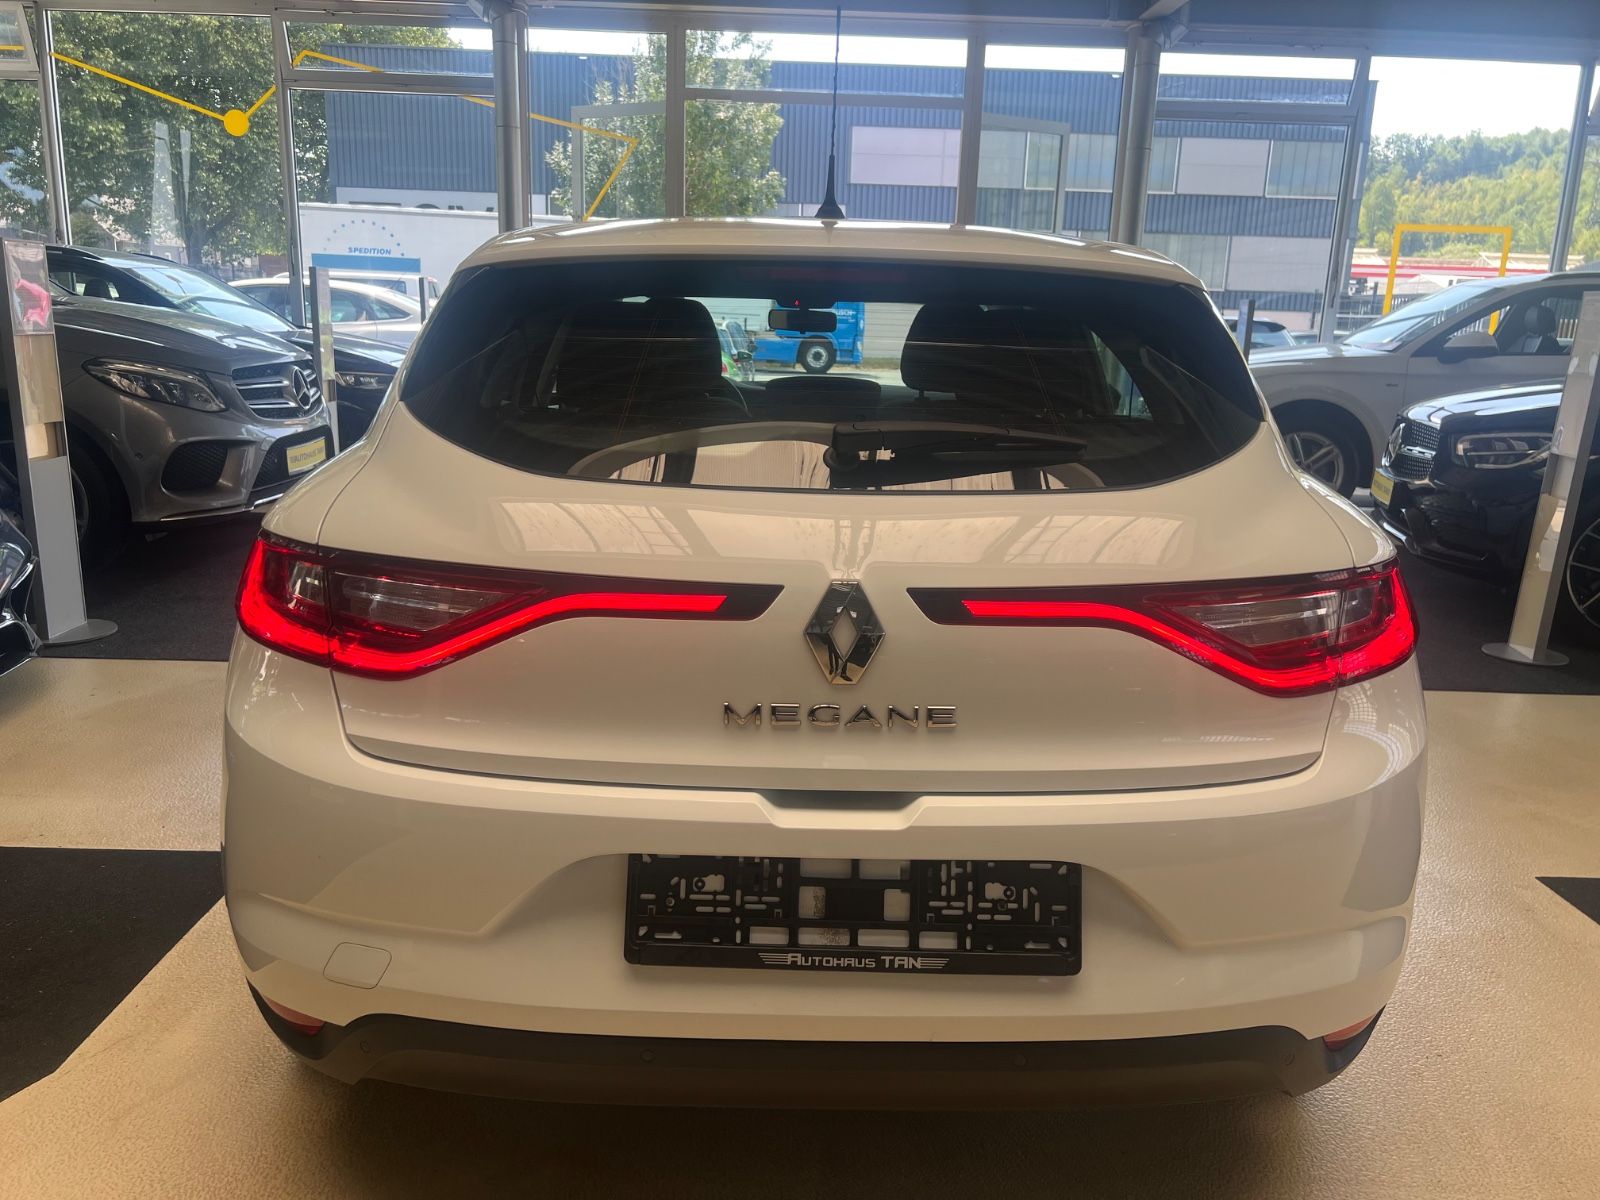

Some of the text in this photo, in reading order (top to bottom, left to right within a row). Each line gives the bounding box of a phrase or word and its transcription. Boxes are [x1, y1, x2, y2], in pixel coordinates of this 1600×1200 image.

[348, 246, 392, 255] SPEDITION
[723, 702, 957, 728] MEGANE
[787, 953, 921, 969] AUTOHAUS TAN
